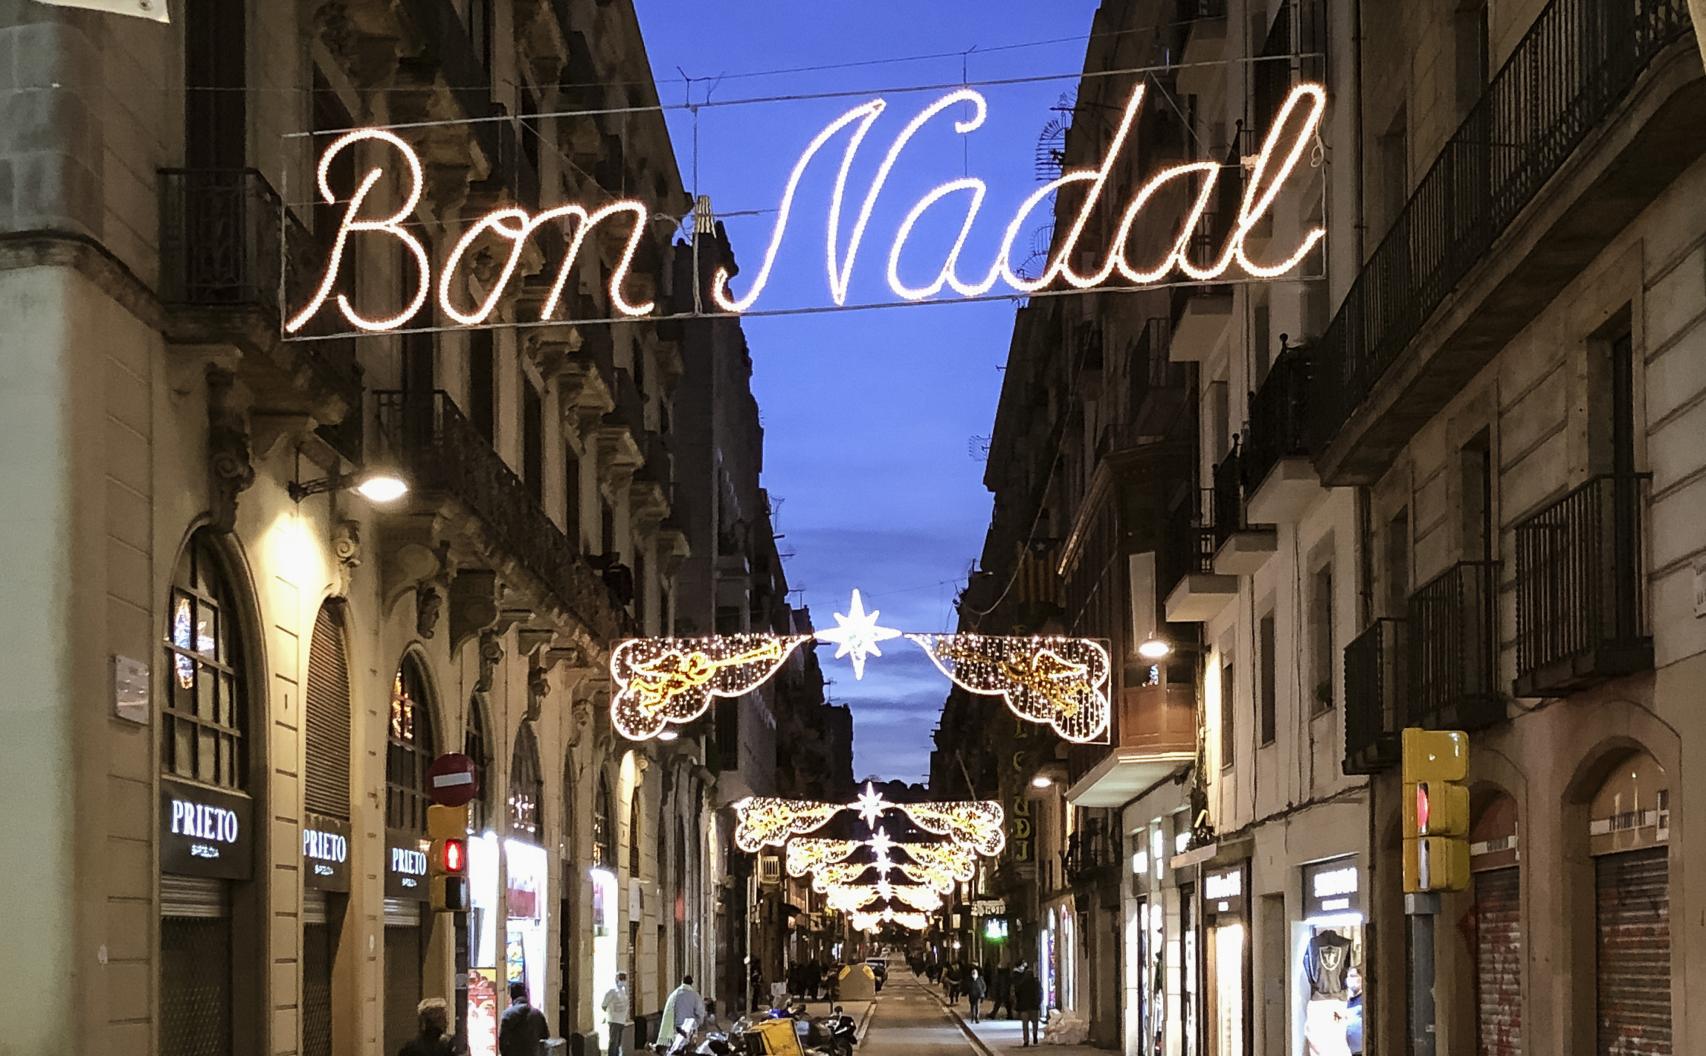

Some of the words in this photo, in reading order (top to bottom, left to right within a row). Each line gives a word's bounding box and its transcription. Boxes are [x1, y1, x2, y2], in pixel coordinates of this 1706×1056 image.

[286, 129, 654, 332] Bon
[713, 82, 1327, 312] Nadal
[171, 799, 238, 843] PRIETO
[303, 829, 347, 863] PRIETO
[392, 847, 427, 875] PRIETO
